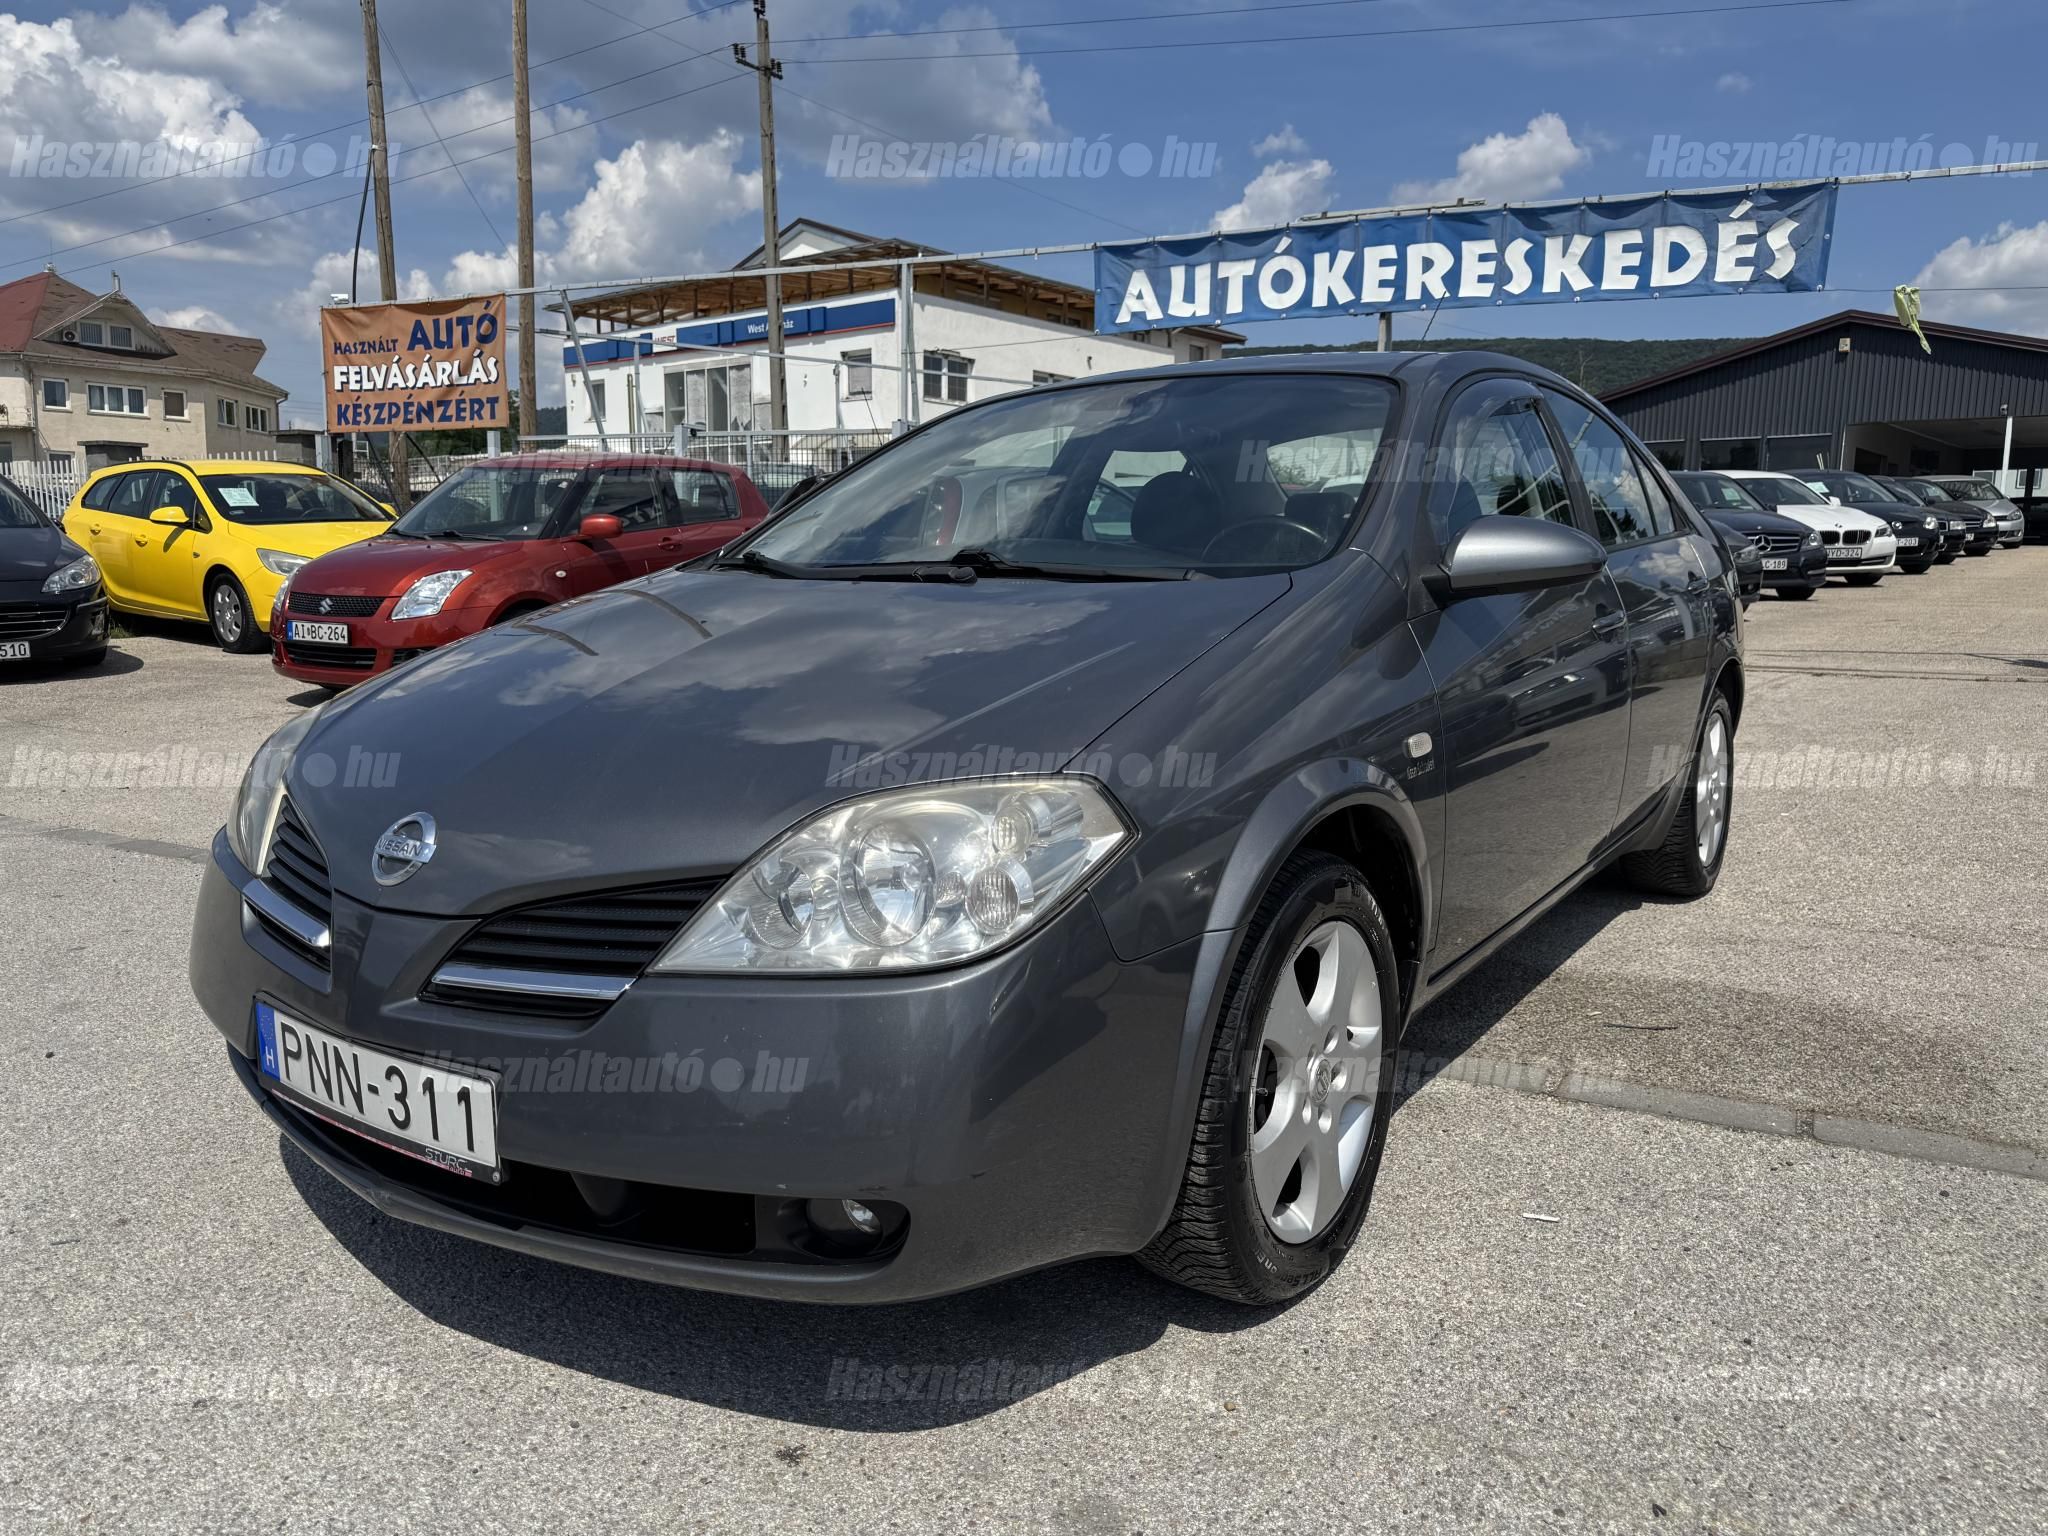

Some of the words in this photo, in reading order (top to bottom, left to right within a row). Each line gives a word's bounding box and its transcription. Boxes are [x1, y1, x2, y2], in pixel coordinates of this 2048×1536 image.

[1114, 198, 1801, 324] AUTÓKERESKEDÉS
[333, 336, 399, 355] HASZNÁLT
[407, 300, 498, 351] AUTÓ
[747, 322, 765, 334] West
[333, 348, 499, 393] FELVÁSÁRLÁS
[336, 390, 500, 426] KÉSZPÉNZÉRT
[1762, 559, 1786, 569] C-189
[378, 838, 423, 858] NISSAN
[280, 1021, 475, 1153] PNN-311
